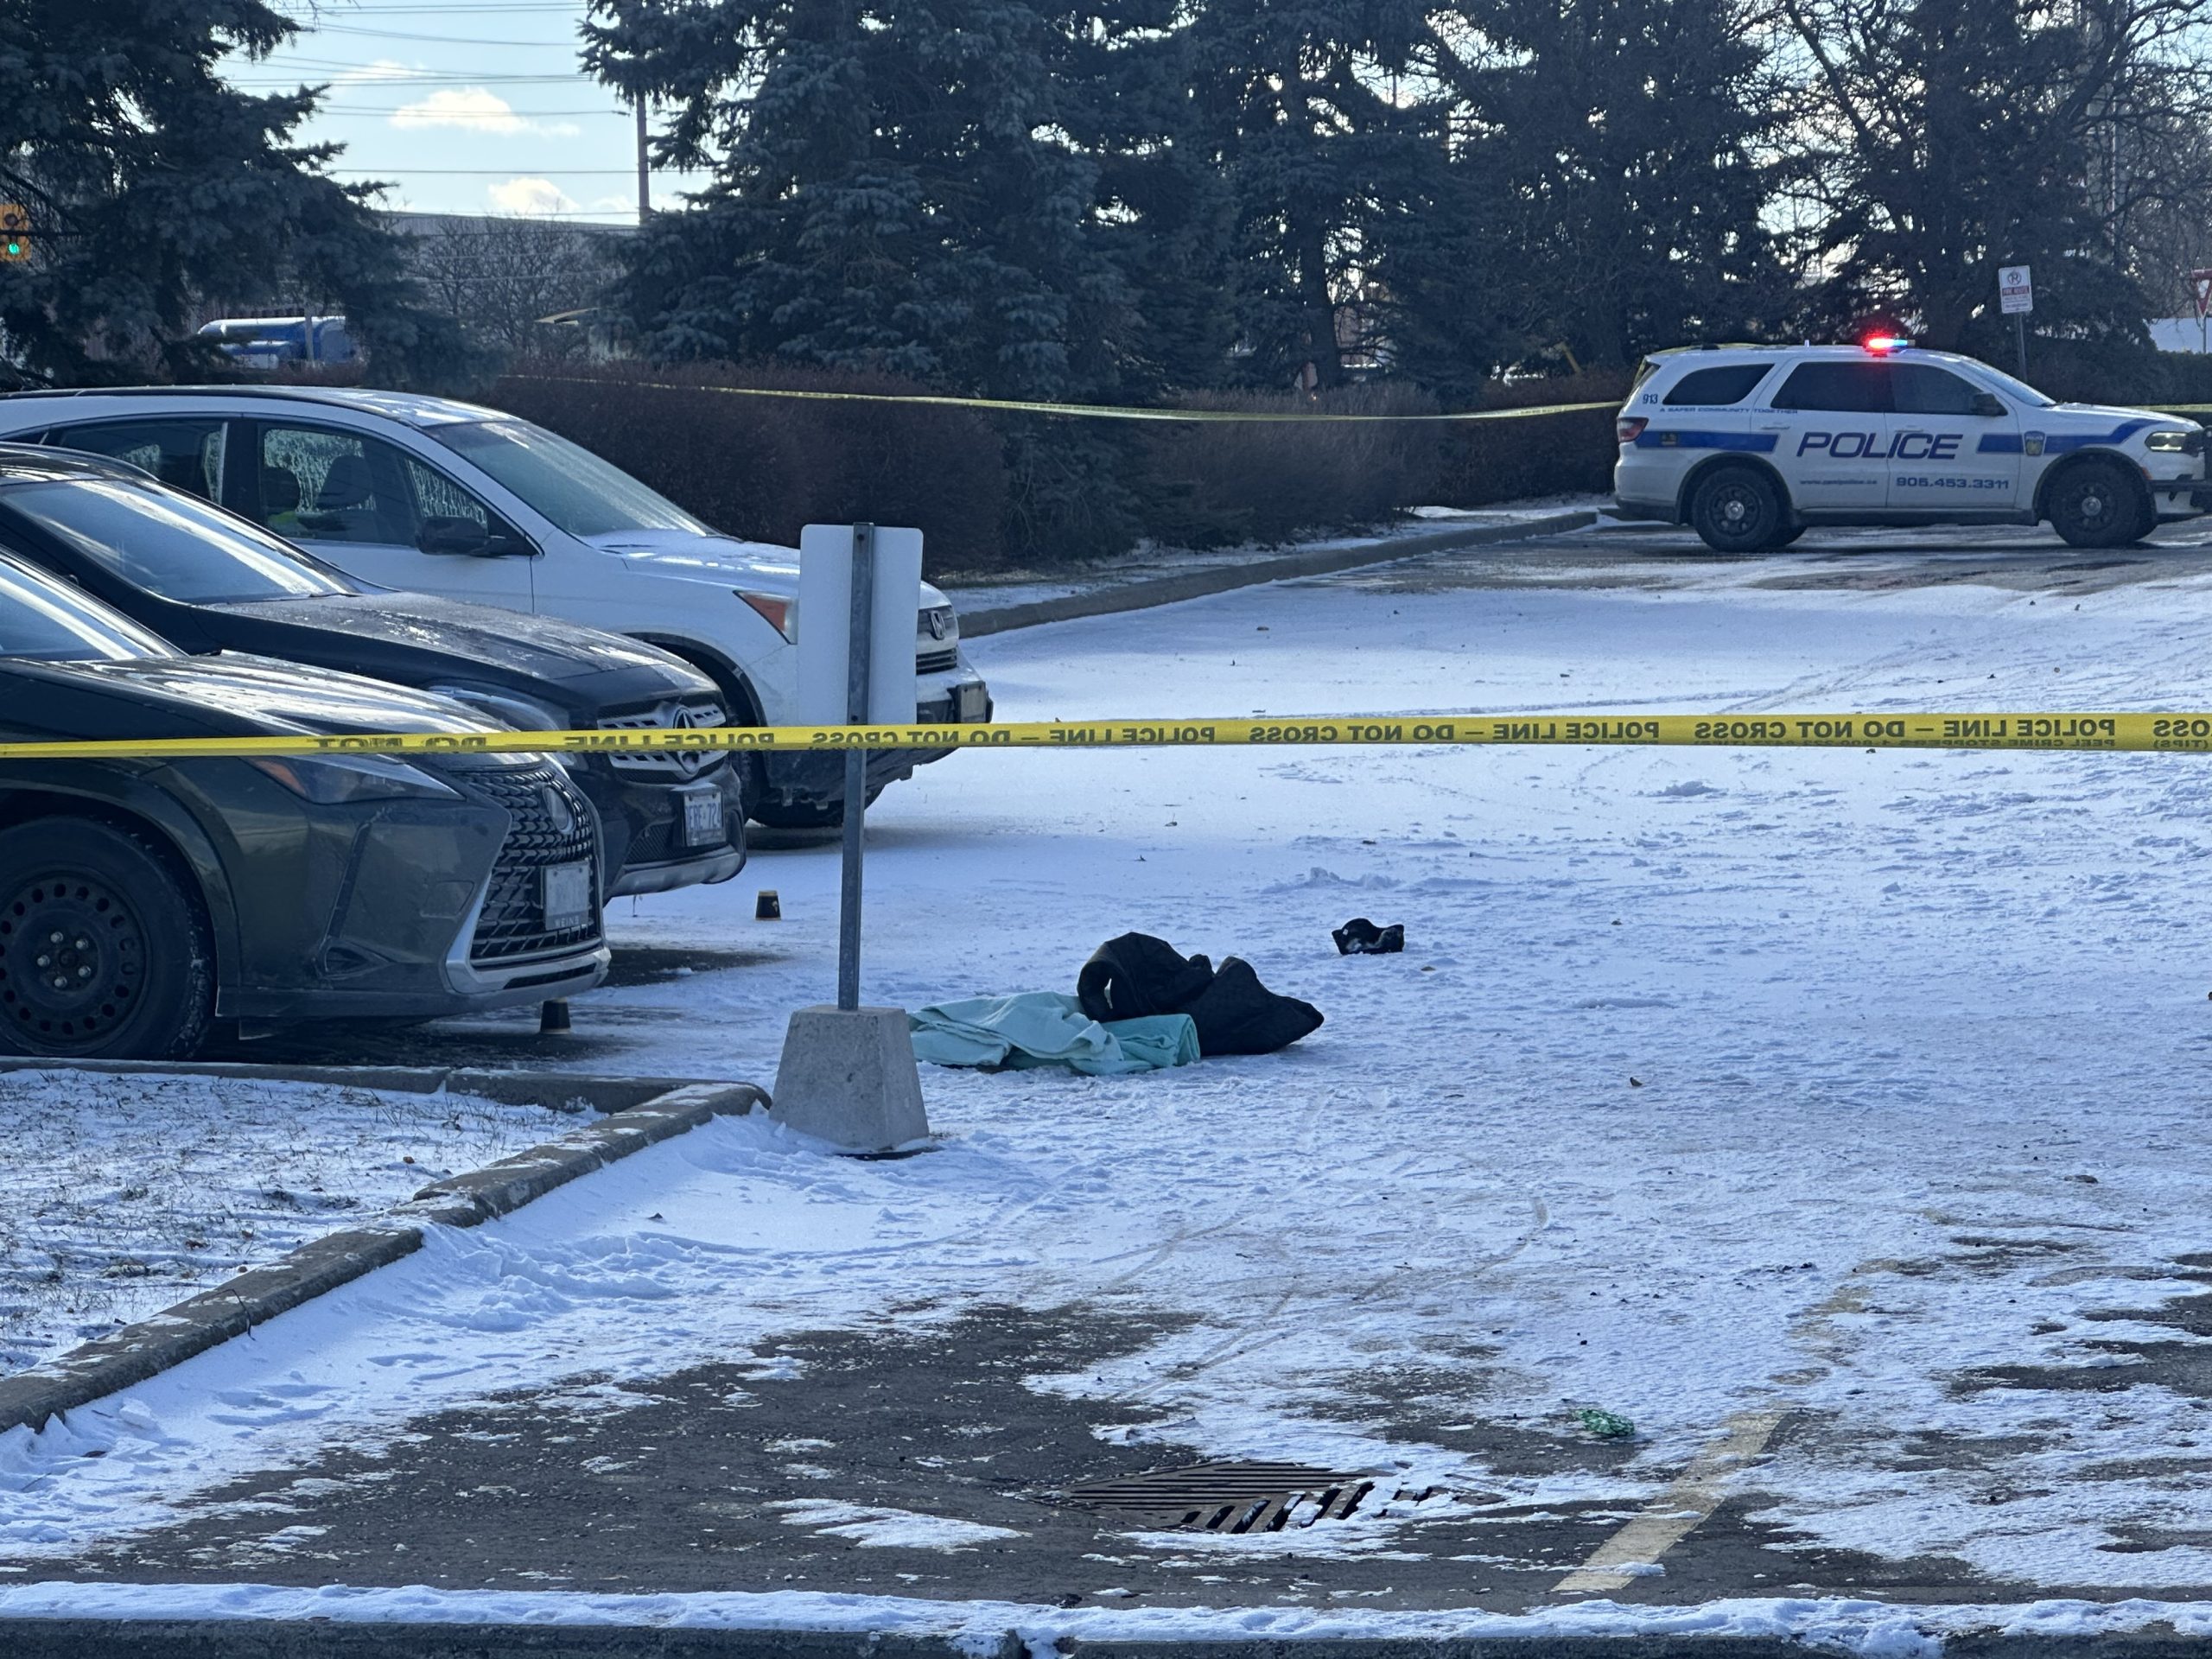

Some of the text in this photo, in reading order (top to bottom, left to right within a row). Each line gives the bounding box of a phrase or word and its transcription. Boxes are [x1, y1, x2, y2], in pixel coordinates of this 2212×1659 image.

[1643, 394, 1658, 404] 913
[1796, 432, 1963, 460] POLICE
[1896, 477, 2010, 489] 905.453.3311
